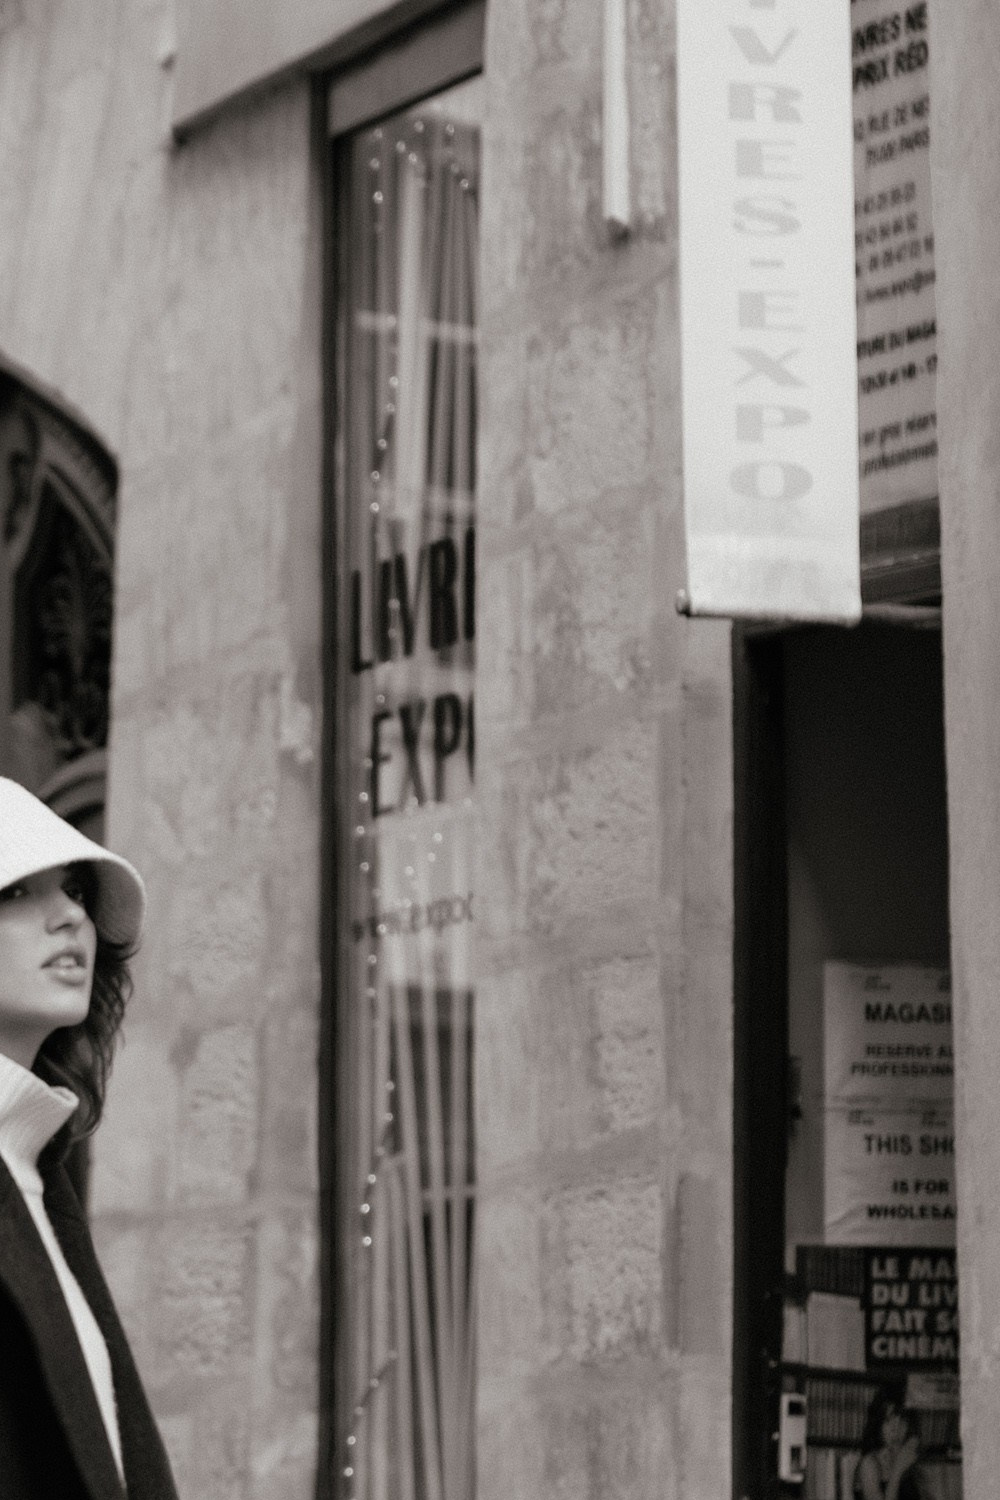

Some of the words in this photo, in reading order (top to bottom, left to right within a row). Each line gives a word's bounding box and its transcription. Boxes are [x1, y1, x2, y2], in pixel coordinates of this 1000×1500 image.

[864, 1134, 911, 1154] THIS
[914, 1181, 948, 1193] FOR
[871, 1257, 899, 1279] LE
[872, 1283, 909, 1306] DU
[872, 1309, 926, 1332] FAIT
